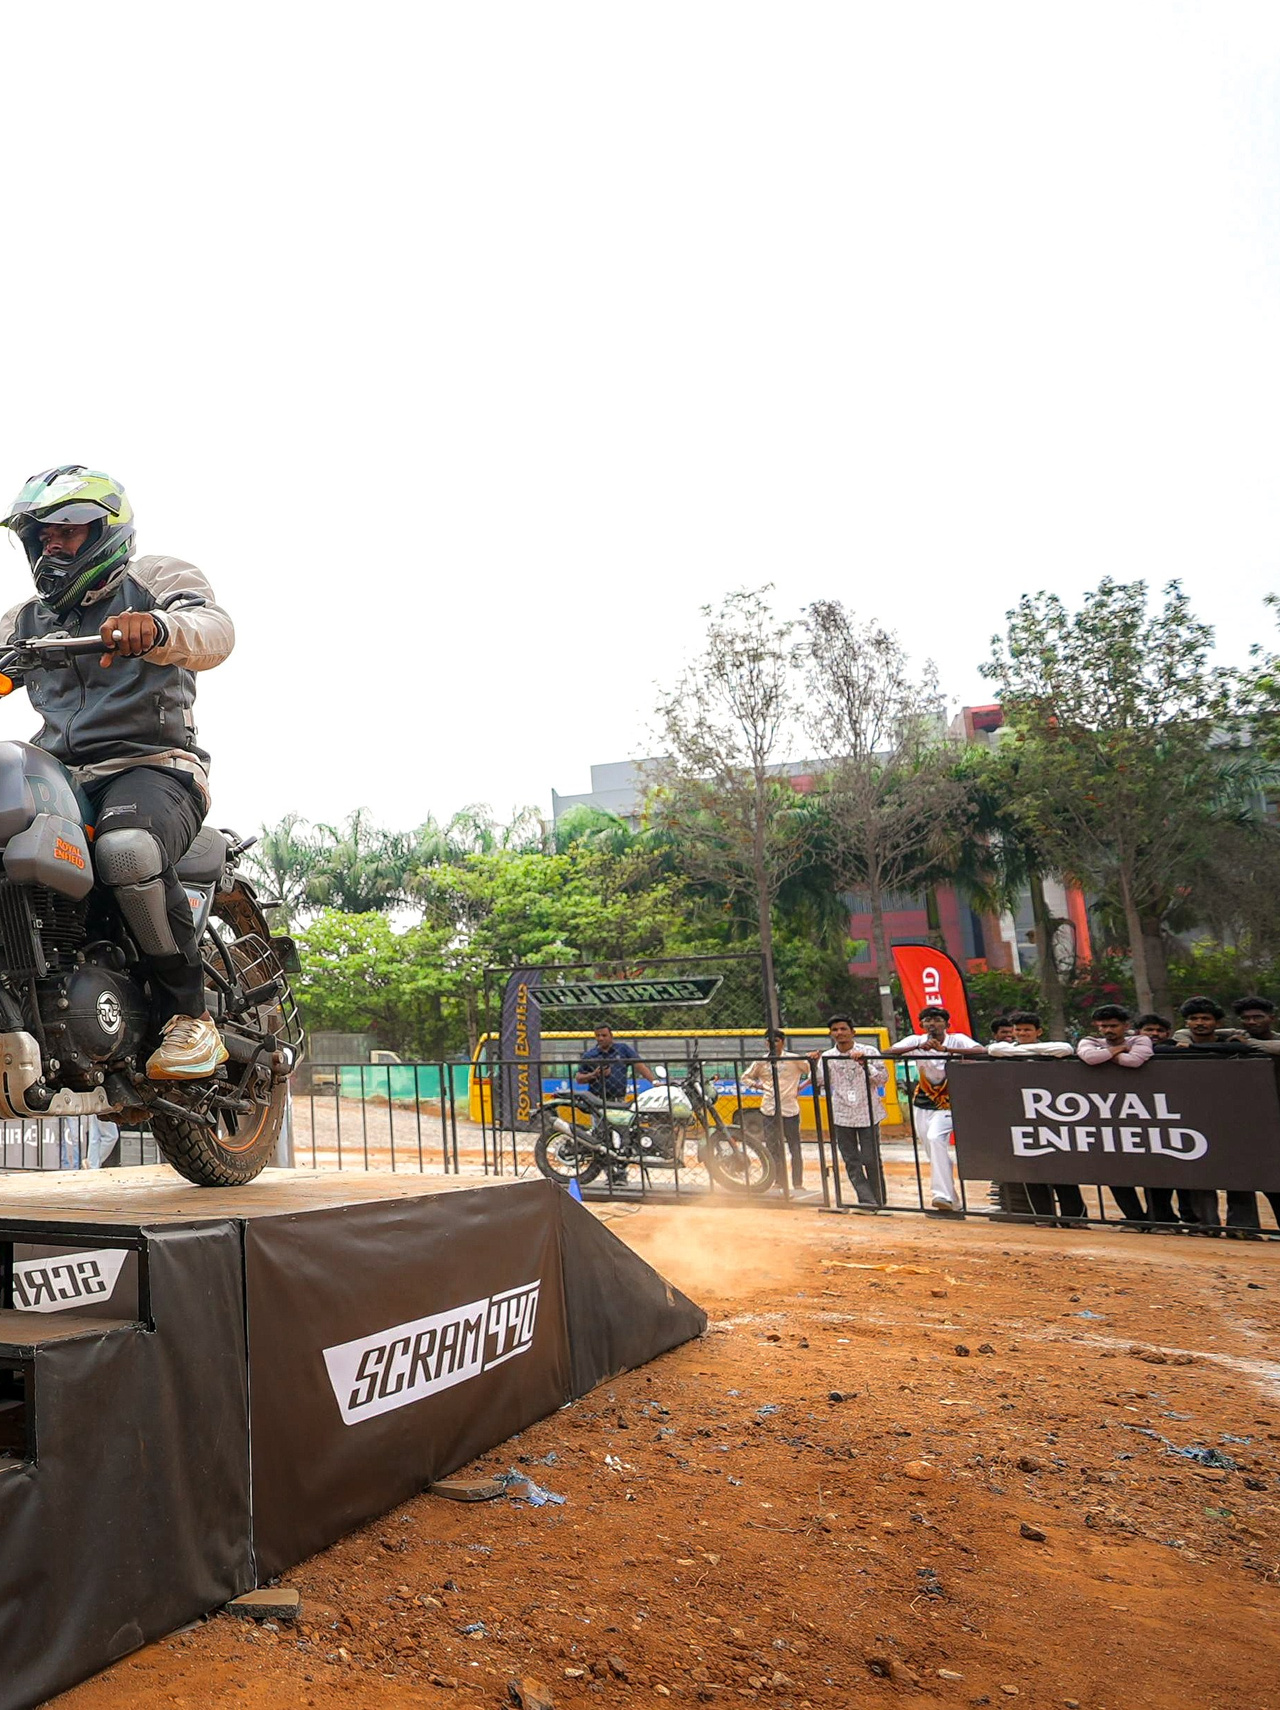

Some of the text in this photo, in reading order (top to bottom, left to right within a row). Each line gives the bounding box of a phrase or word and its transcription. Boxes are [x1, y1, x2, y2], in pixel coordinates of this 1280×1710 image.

[53, 848, 85, 869] ENFIELD
[56, 837, 82, 858] ROYAL
[922, 966, 943, 1009] ELD
[1020, 1087, 1182, 1123] ROYAL
[1010, 1125, 1209, 1161] ENFIELD
[348, 1289, 540, 1411] SCRAM 440
